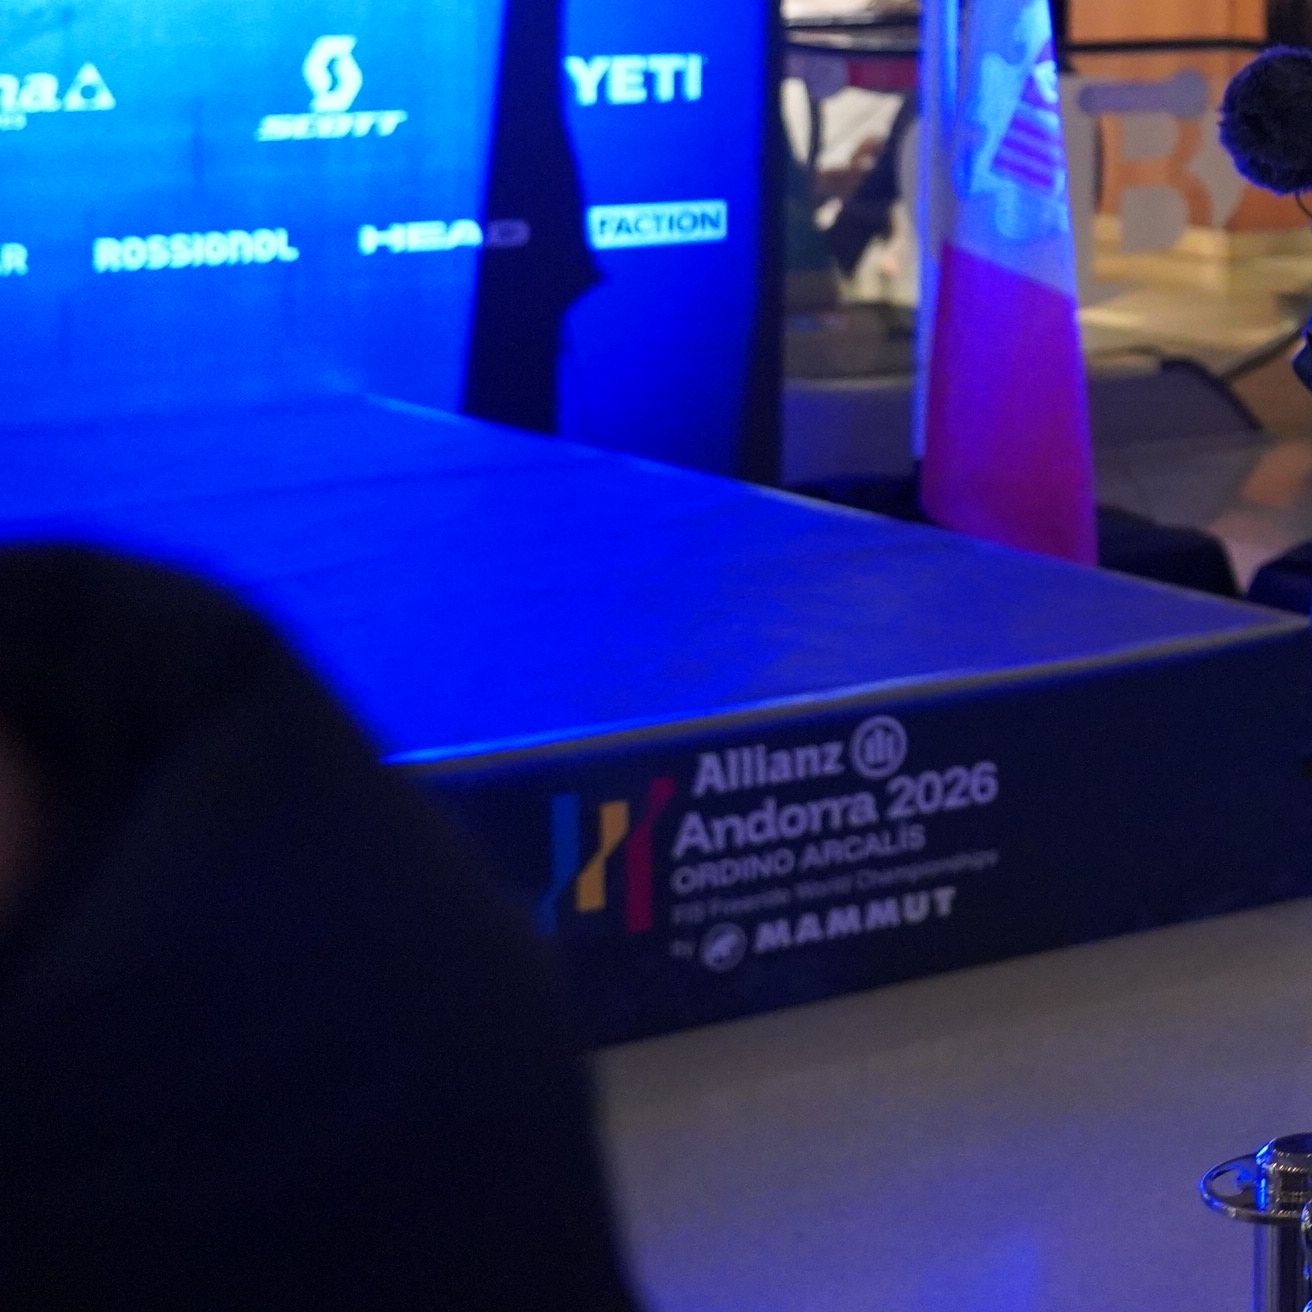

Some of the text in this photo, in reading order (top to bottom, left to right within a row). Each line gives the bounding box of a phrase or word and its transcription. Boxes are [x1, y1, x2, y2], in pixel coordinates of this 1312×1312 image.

[565, 53, 706, 106] YETI
[356, 217, 531, 256] HEAD
[693, 739, 845, 797] Allianz
[672, 761, 998, 857] Andorra 2026
[670, 847, 796, 894] ORDINO
[751, 886, 958, 953] MAMMUT
